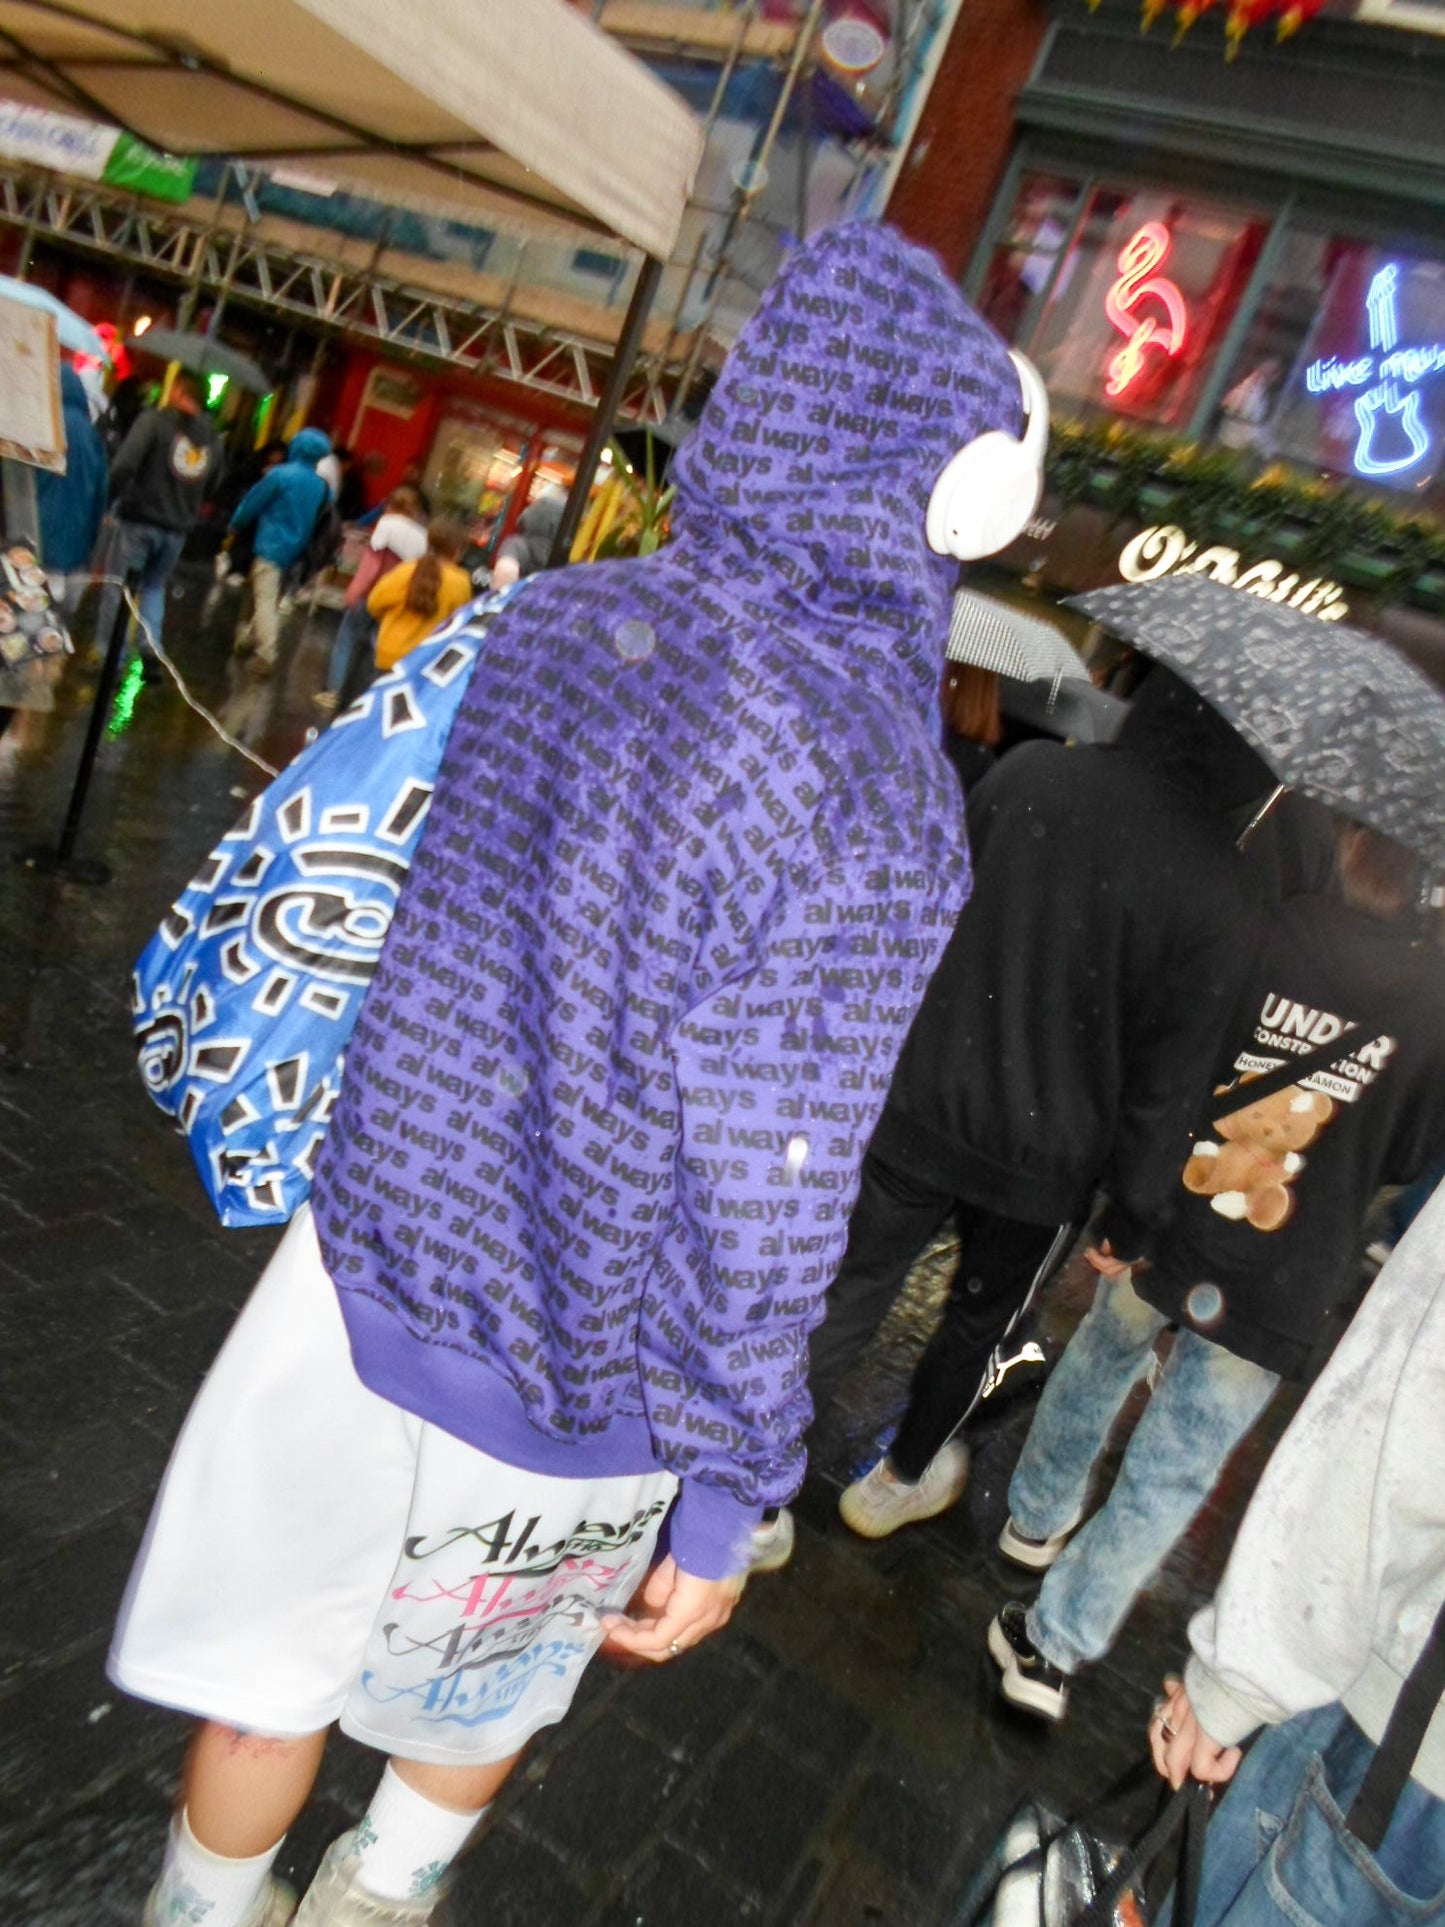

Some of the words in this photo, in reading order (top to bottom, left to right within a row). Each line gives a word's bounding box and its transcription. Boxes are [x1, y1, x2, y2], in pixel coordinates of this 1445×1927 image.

[825, 333, 918, 379] always
[807, 402, 897, 441] always
[865, 382, 952, 420] always
[730, 418, 830, 457] always
[786, 508, 889, 541] always
[803, 898, 911, 928] always
[849, 929, 938, 965] always
[390, 942, 487, 1002] always
[792, 961, 903, 996] always
[369, 998, 463, 1058] always
[424, 997, 518, 1056] always
[712, 994, 826, 1024] always
[842, 996, 912, 1026] alwa
[1260, 992, 1397, 1071] UNDR
[780, 1028, 895, 1061] always
[1254, 1026, 1376, 1085] CONSTRION
[397, 1052, 495, 1110] always
[700, 1056, 820, 1090] always
[553, 1079, 649, 1151] always
[776, 1092, 880, 1130] always
[369, 1107, 468, 1163] always
[584, 1140, 672, 1195] always
[347, 1162, 442, 1220] always
[421, 1167, 512, 1224] always
[693, 1189, 800, 1227] always
[394, 1223, 479, 1275] always
[448, 1215, 536, 1282] always
